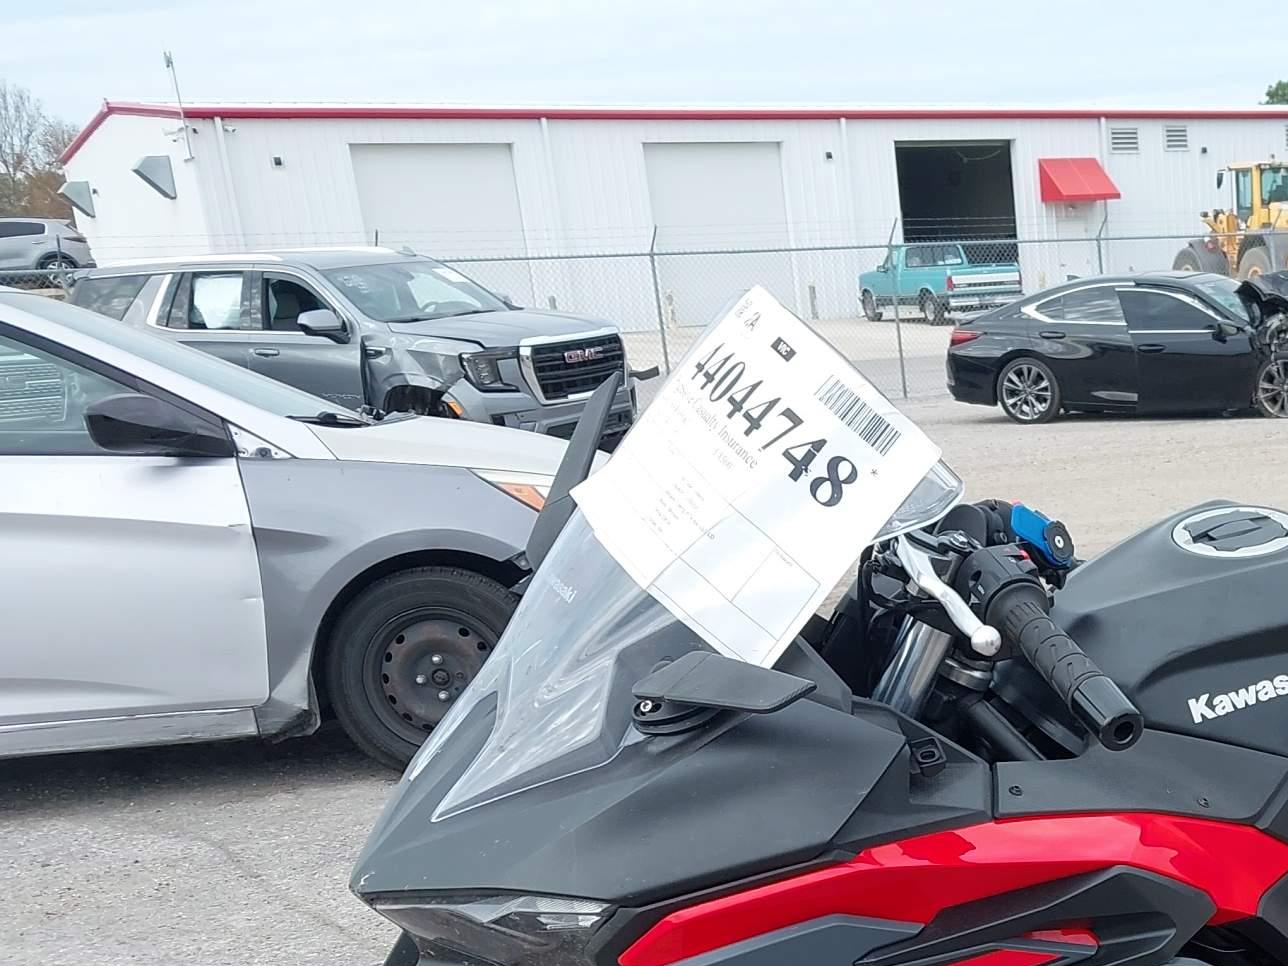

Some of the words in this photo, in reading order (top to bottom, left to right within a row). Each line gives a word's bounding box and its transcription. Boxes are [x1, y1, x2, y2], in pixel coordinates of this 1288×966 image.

[564, 346, 603, 363] GMC
[690, 342, 858, 508] 44044748
[719, 425, 759, 470] Insurance
